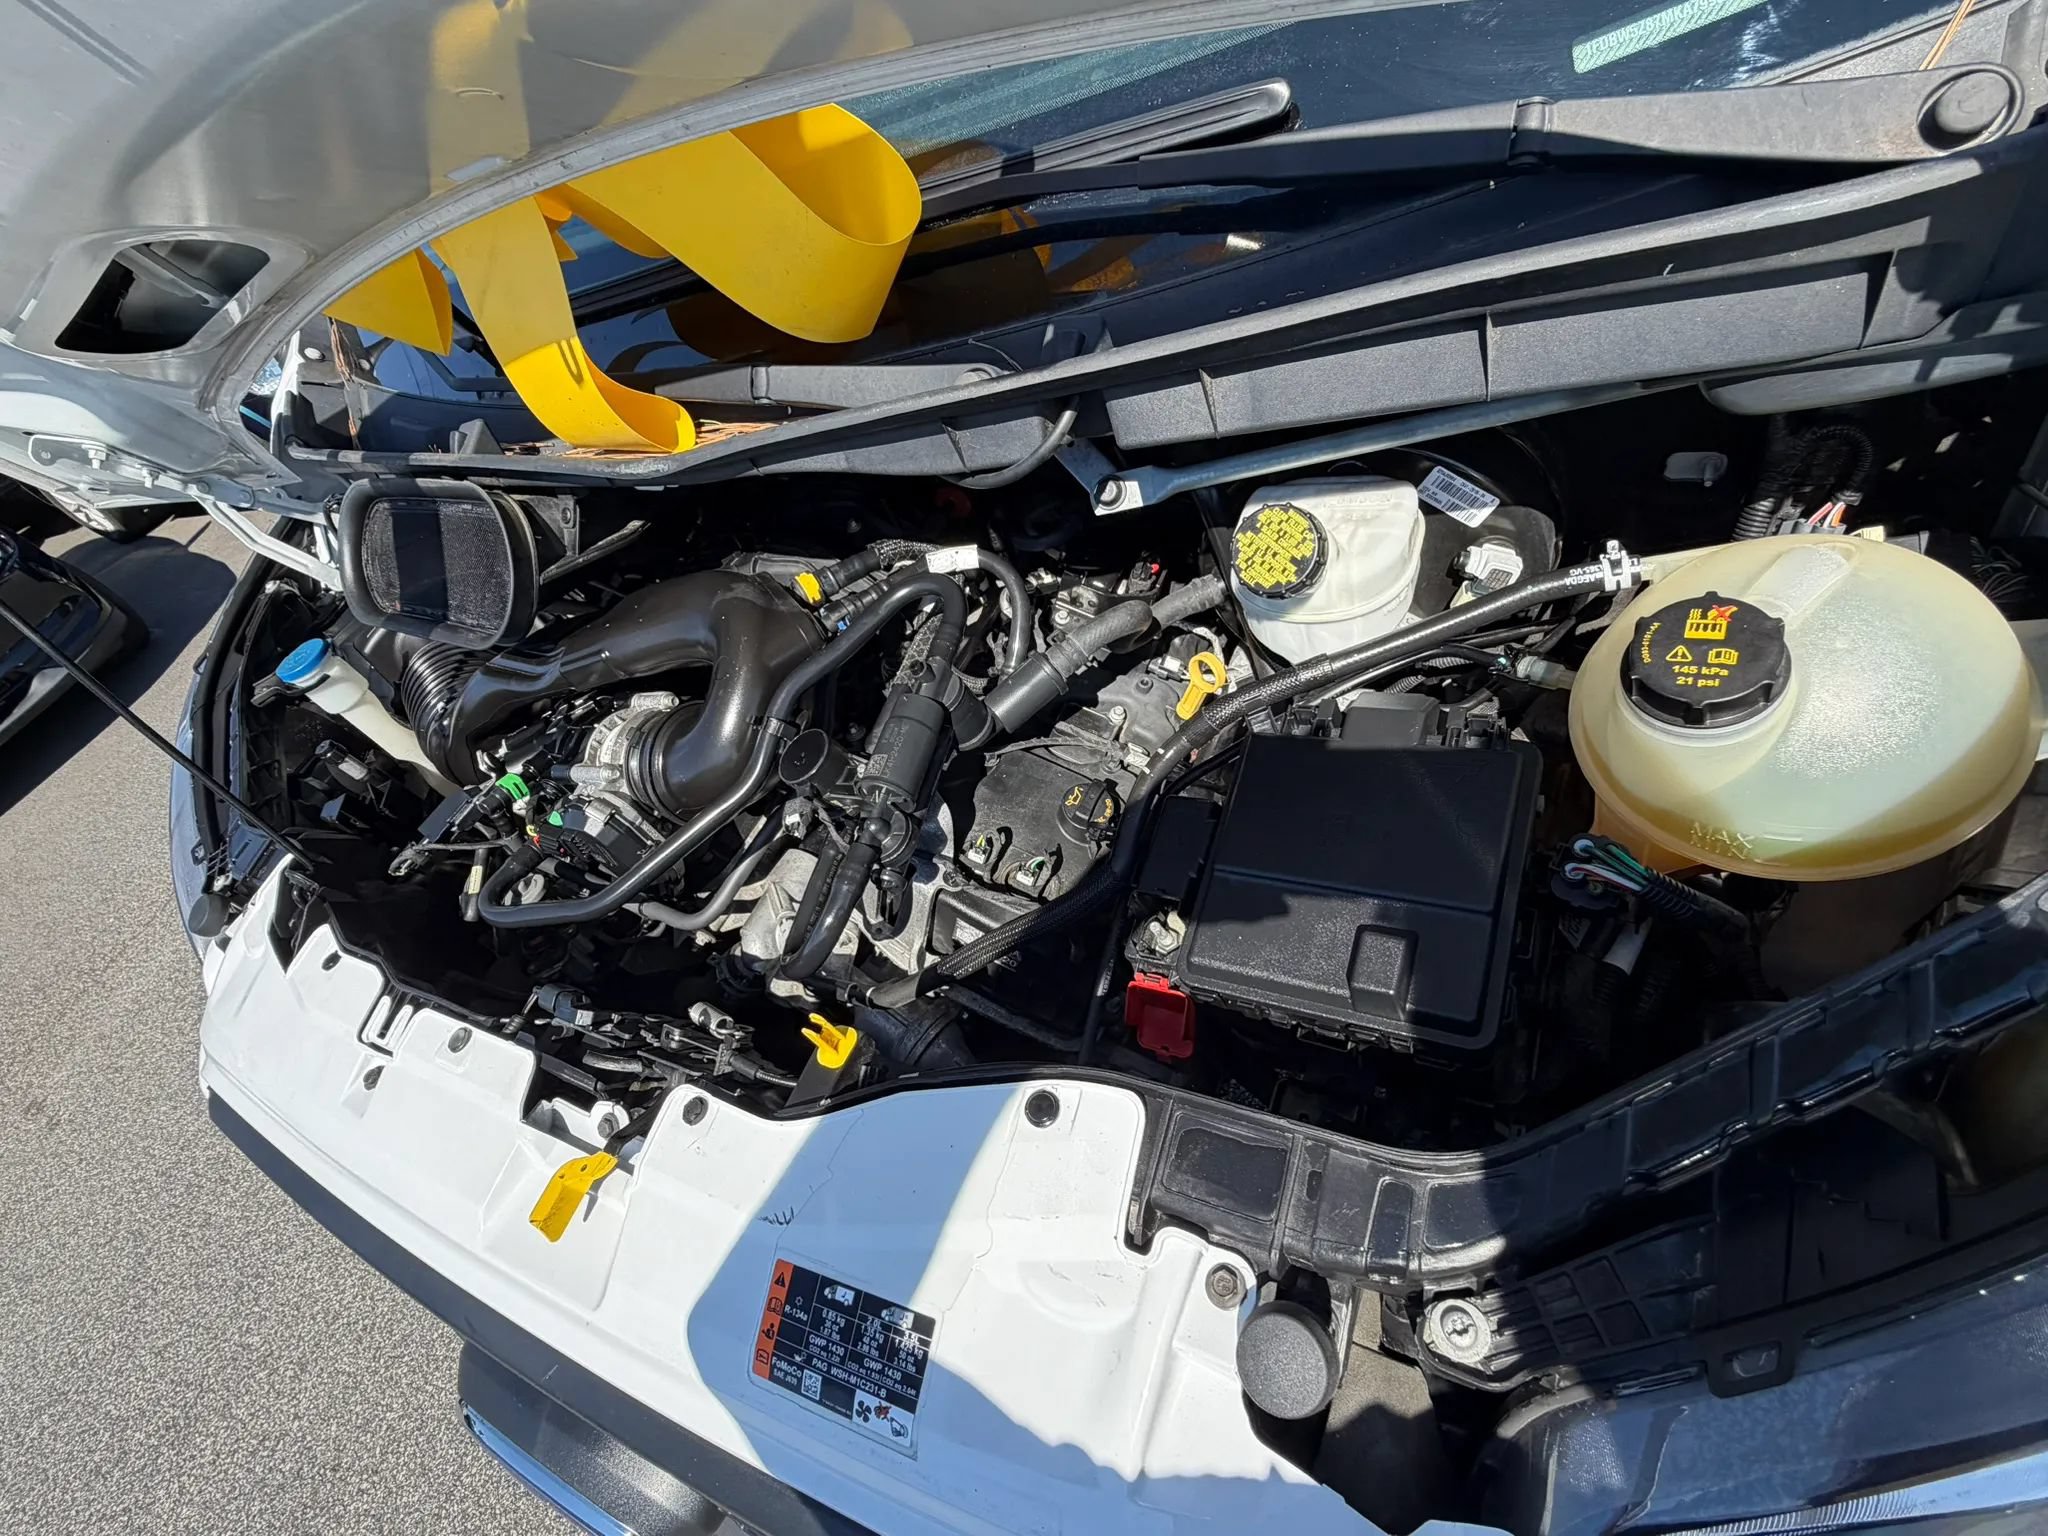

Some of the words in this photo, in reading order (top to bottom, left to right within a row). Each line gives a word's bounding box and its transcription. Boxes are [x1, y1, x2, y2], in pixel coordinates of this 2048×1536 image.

[1672, 665, 1698, 674] 145
[1701, 665, 1729, 676] kPa
[1676, 677, 1693, 685] 21
[1697, 677, 1720, 687] psi
[1690, 822, 1755, 849] MAX
[784, 1304, 807, 1320] R-134a
[836, 1315, 845, 1327] kg
[808, 1334, 826, 1346] GWP
[828, 1342, 844, 1356] 1430
[875, 1331, 884, 1343] kg
[913, 1346, 923, 1359] kg
[771, 1358, 801, 1377] FoMoCo
[863, 1357, 882, 1371] GWP
[884, 1366, 901, 1380] 1430
[811, 1357, 827, 1371] PAG
[829, 1369, 887, 1397] WSH-M1C231-B
